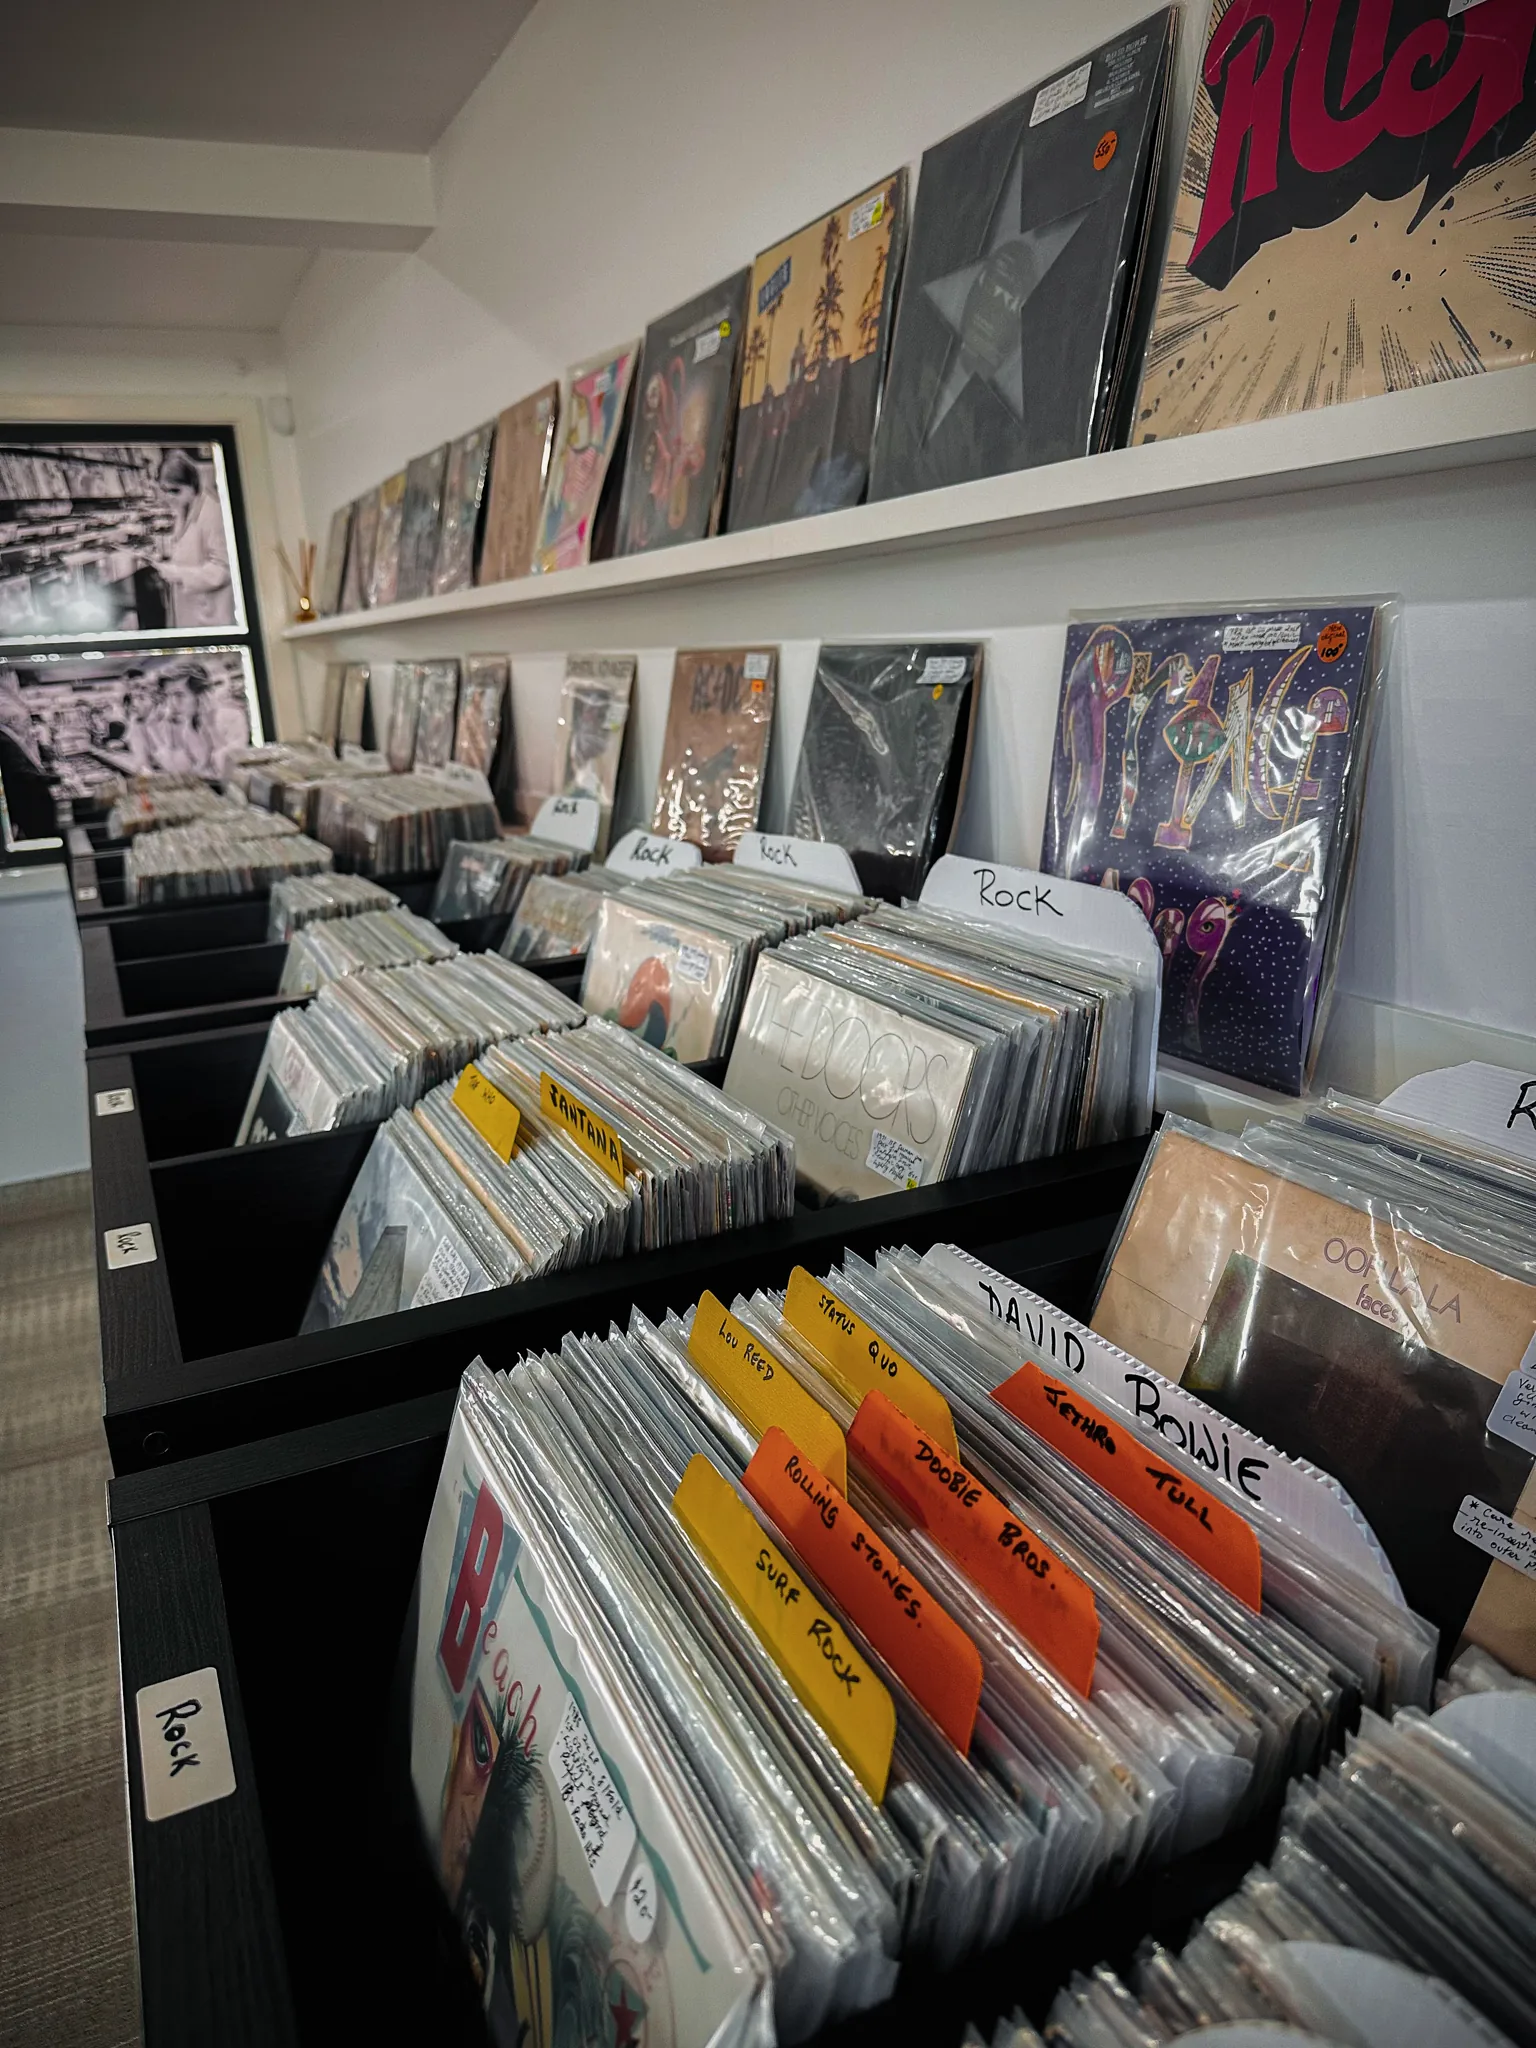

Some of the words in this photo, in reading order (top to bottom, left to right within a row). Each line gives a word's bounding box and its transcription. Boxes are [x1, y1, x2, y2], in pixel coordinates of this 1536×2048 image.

[630, 837, 673, 865] Rock
[759, 836, 798, 867] Rock
[973, 868, 1064, 917] Rock
[801, 1004, 949, 1145] DOORS
[550, 1083, 622, 1173] SANTANA
[818, 1294, 857, 1336] STATUS
[867, 1340, 899, 1378] QUO
[978, 1280, 1086, 1374] DAVID
[1355, 1283, 1399, 1324] faces
[1426, 1283, 1461, 1324] LA
[743, 1342, 775, 1382] REED
[1043, 1385, 1117, 1456] JETHRO
[1145, 1466, 1214, 1534] TULL
[1461, 1523, 1483, 1539] into
[1490, 1541, 1521, 1561] outer
[439, 1478, 538, 1759] Beach
[754, 1548, 801, 1606] SURF
[807, 1618, 862, 1698] ROCK
[155, 1698, 203, 1777] Rock
